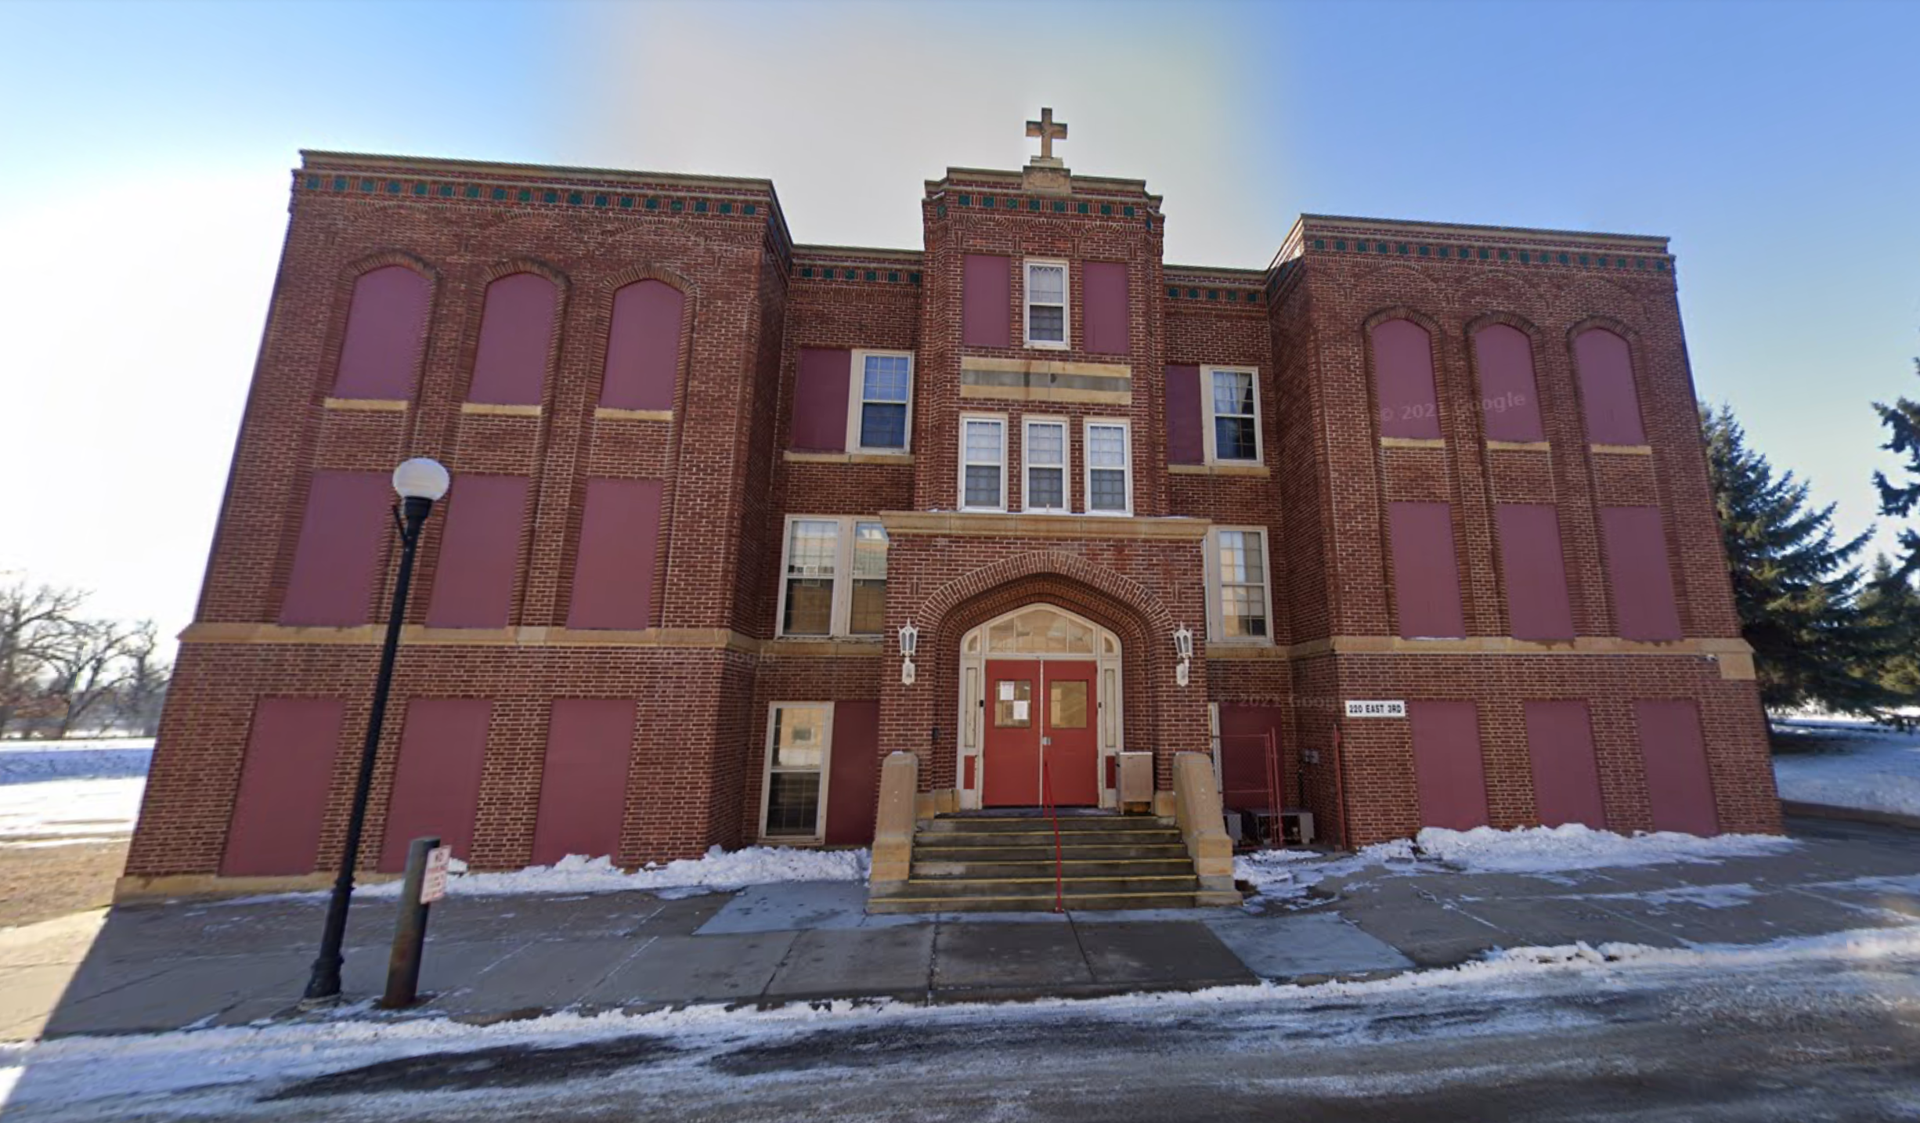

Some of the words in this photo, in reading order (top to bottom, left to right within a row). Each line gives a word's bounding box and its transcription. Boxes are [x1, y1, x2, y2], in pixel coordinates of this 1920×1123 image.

[1349, 704, 1363, 714] 220
[1365, 704, 1384, 714] EAST
[1388, 704, 1402, 714] 3RD
